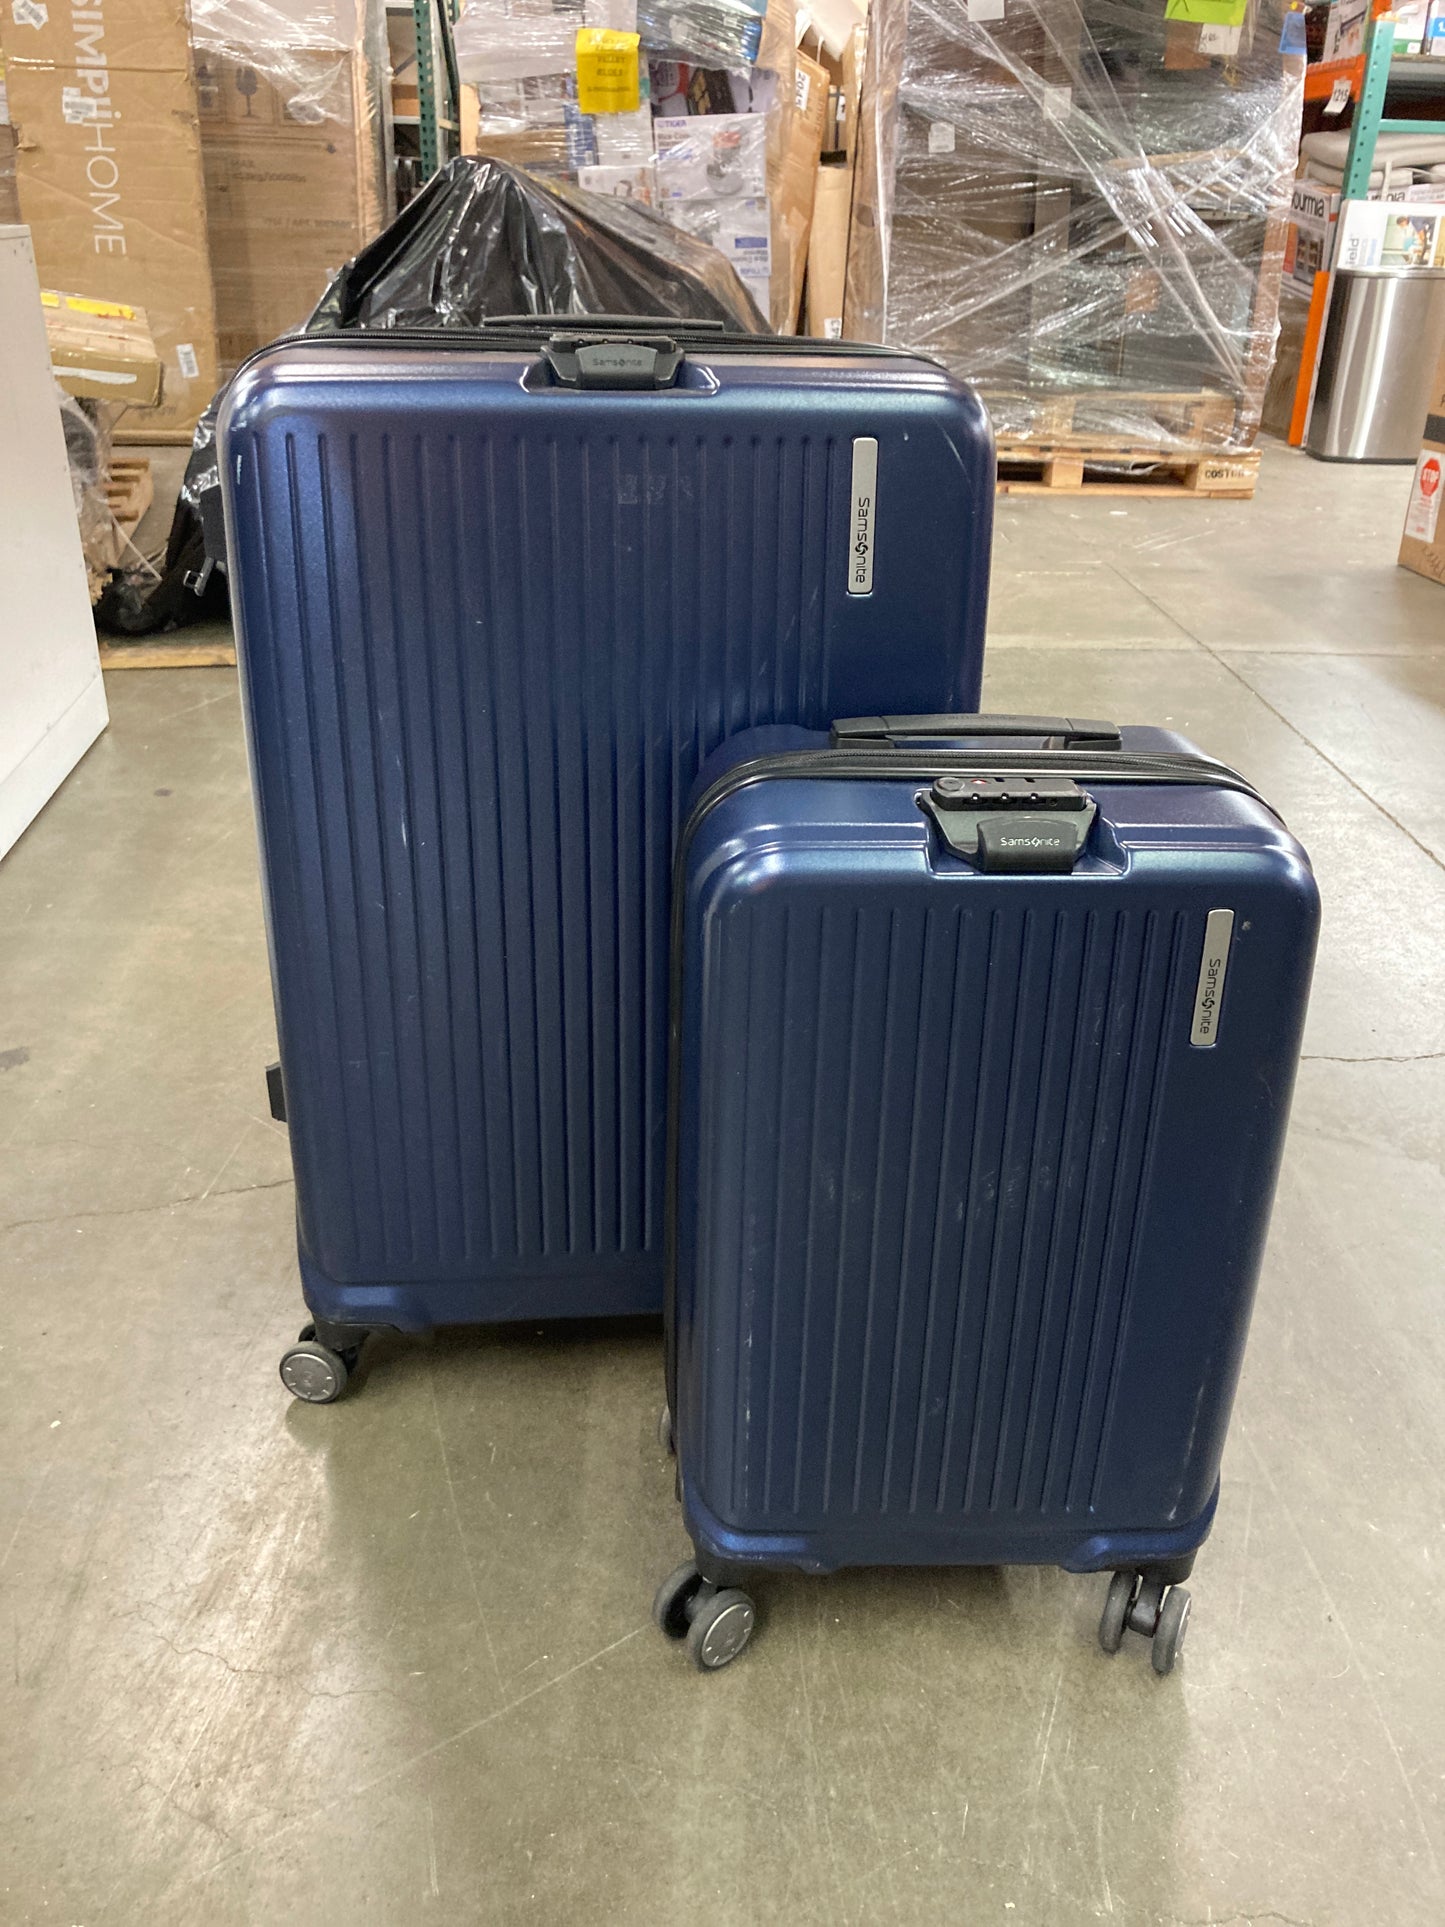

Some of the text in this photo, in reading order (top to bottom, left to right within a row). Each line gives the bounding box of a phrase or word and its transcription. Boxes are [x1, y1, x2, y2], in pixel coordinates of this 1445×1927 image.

[592, 358, 643, 367] Samsonite
[1205, 470, 1244, 479] COST
[855, 497, 870, 584] Samsonite
[1001, 836, 1061, 848] Samsonite
[1199, 958, 1221, 1034] Samsonite
